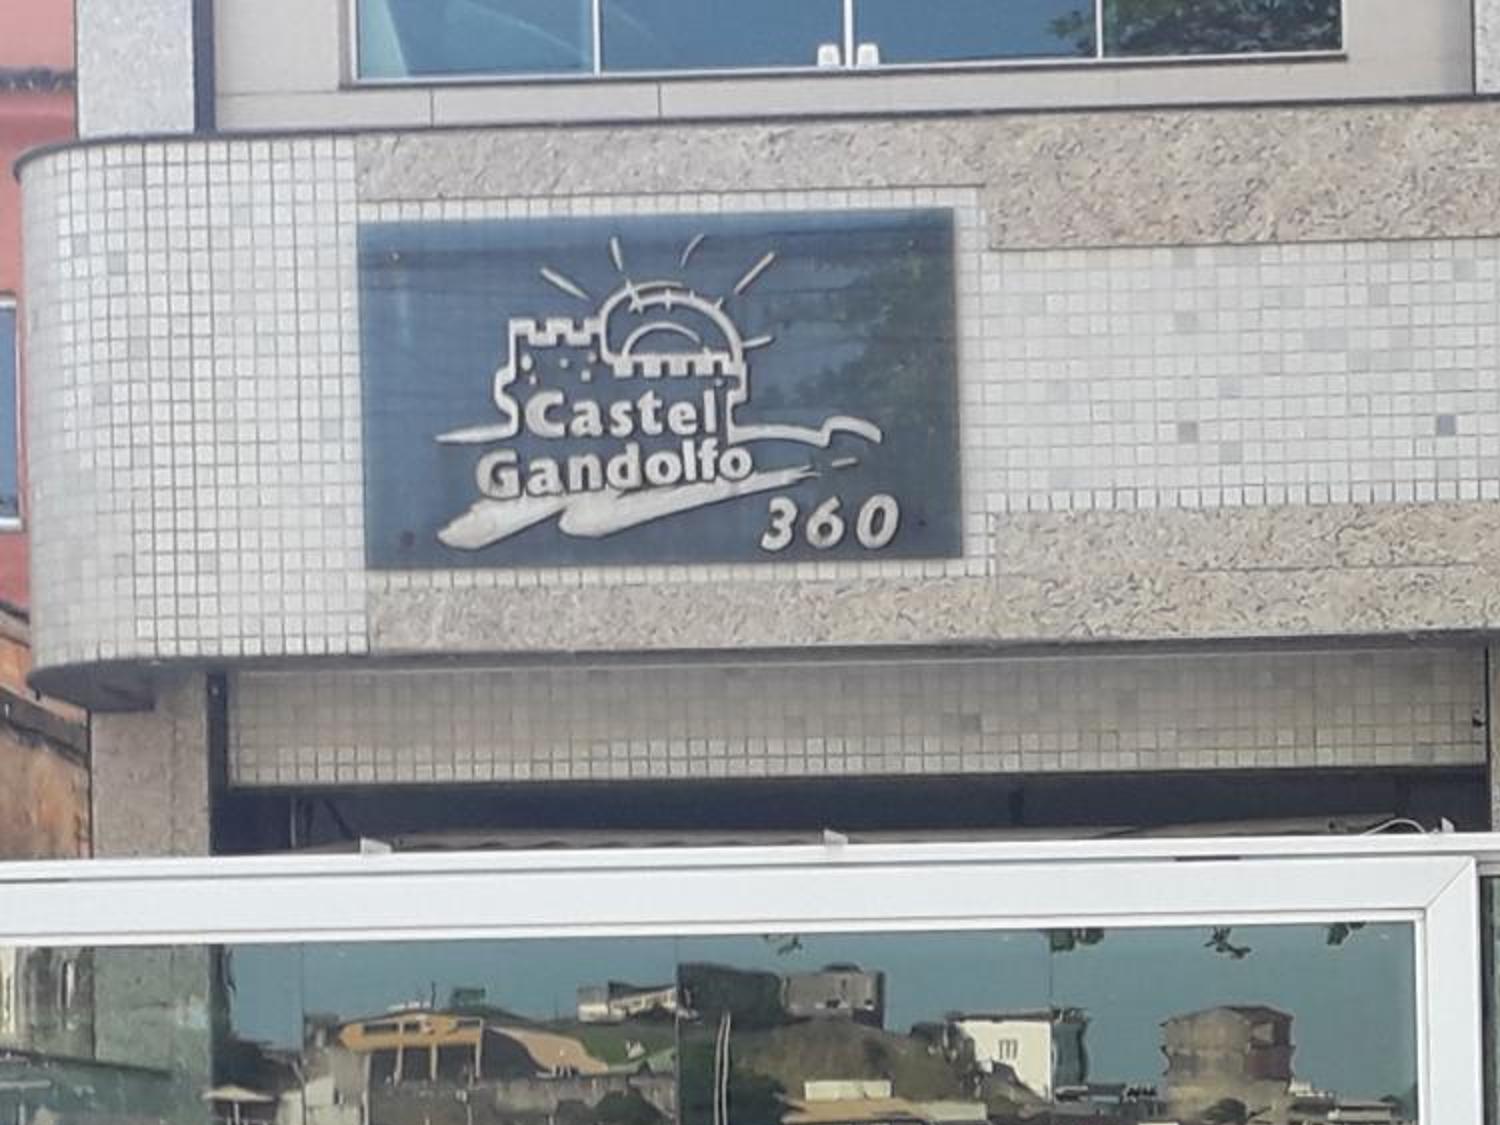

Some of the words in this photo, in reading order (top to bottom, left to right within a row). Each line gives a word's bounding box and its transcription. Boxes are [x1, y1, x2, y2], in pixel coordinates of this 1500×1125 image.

[525, 389, 717, 438] Castel
[475, 442, 755, 499] Gandolfo
[760, 493, 900, 552] 360
